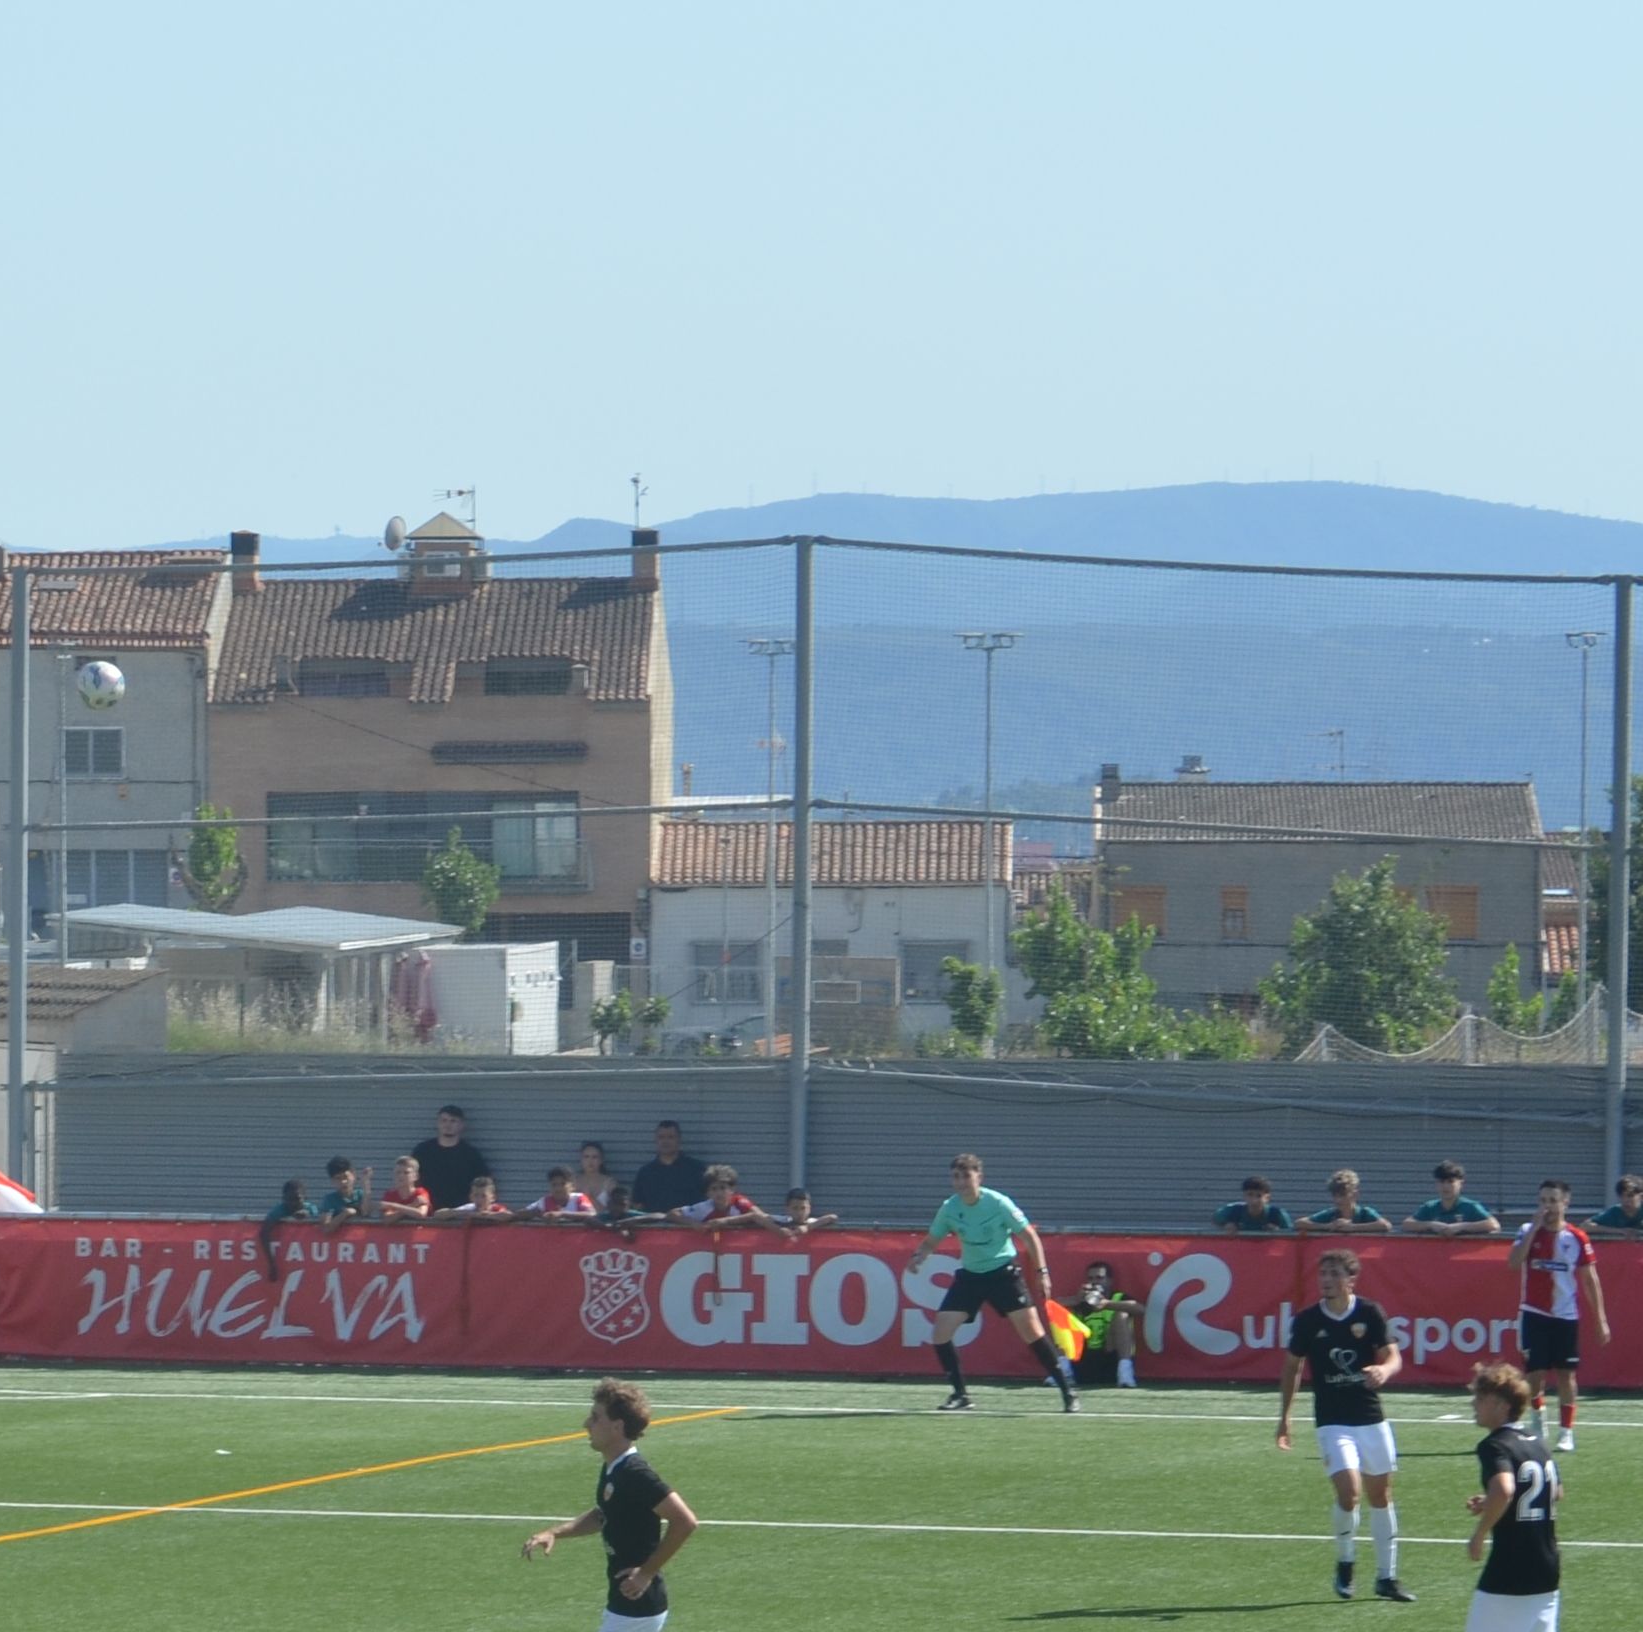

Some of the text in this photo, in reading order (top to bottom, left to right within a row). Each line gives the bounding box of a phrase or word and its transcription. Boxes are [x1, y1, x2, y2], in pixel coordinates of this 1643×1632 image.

[75, 1237, 143, 1258] BAR
[193, 1239, 430, 1264] RESTAURANT
[78, 1264, 426, 1343] HUELVA
[588, 1278, 639, 1319] GIOS
[659, 1251, 982, 1348] GIOS
[1515, 1459, 1559, 1522] 21
